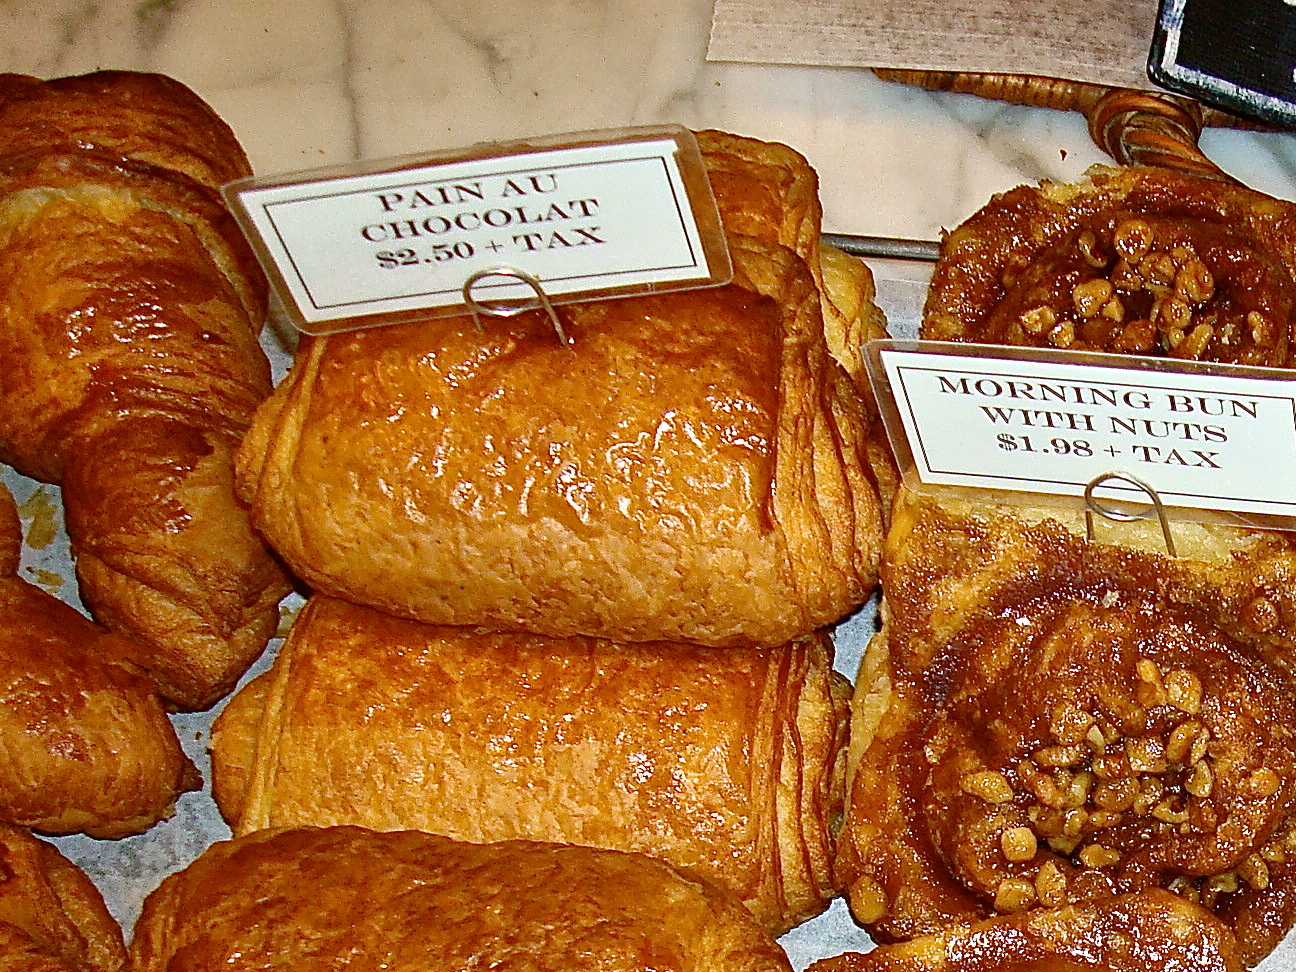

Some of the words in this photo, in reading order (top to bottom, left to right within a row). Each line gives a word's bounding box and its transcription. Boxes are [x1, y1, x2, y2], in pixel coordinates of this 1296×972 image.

[376, 182, 485, 212] PAIN
[502, 174, 559, 197] AU
[361, 199, 600, 243] CHOCOLAT
[375, 241, 475, 270] $2.50
[485, 240, 504, 254] +
[512, 226, 607, 253] TAX
[936, 375, 1154, 412] MORNING
[1166, 394, 1259, 419] BUN
[980, 406, 1097, 433] WITH
[1109, 416, 1229, 444] NUTS
[996, 432, 1094, 458] $1.98
[1103, 445, 1122, 458] +
[1133, 445, 1223, 469] TAX
